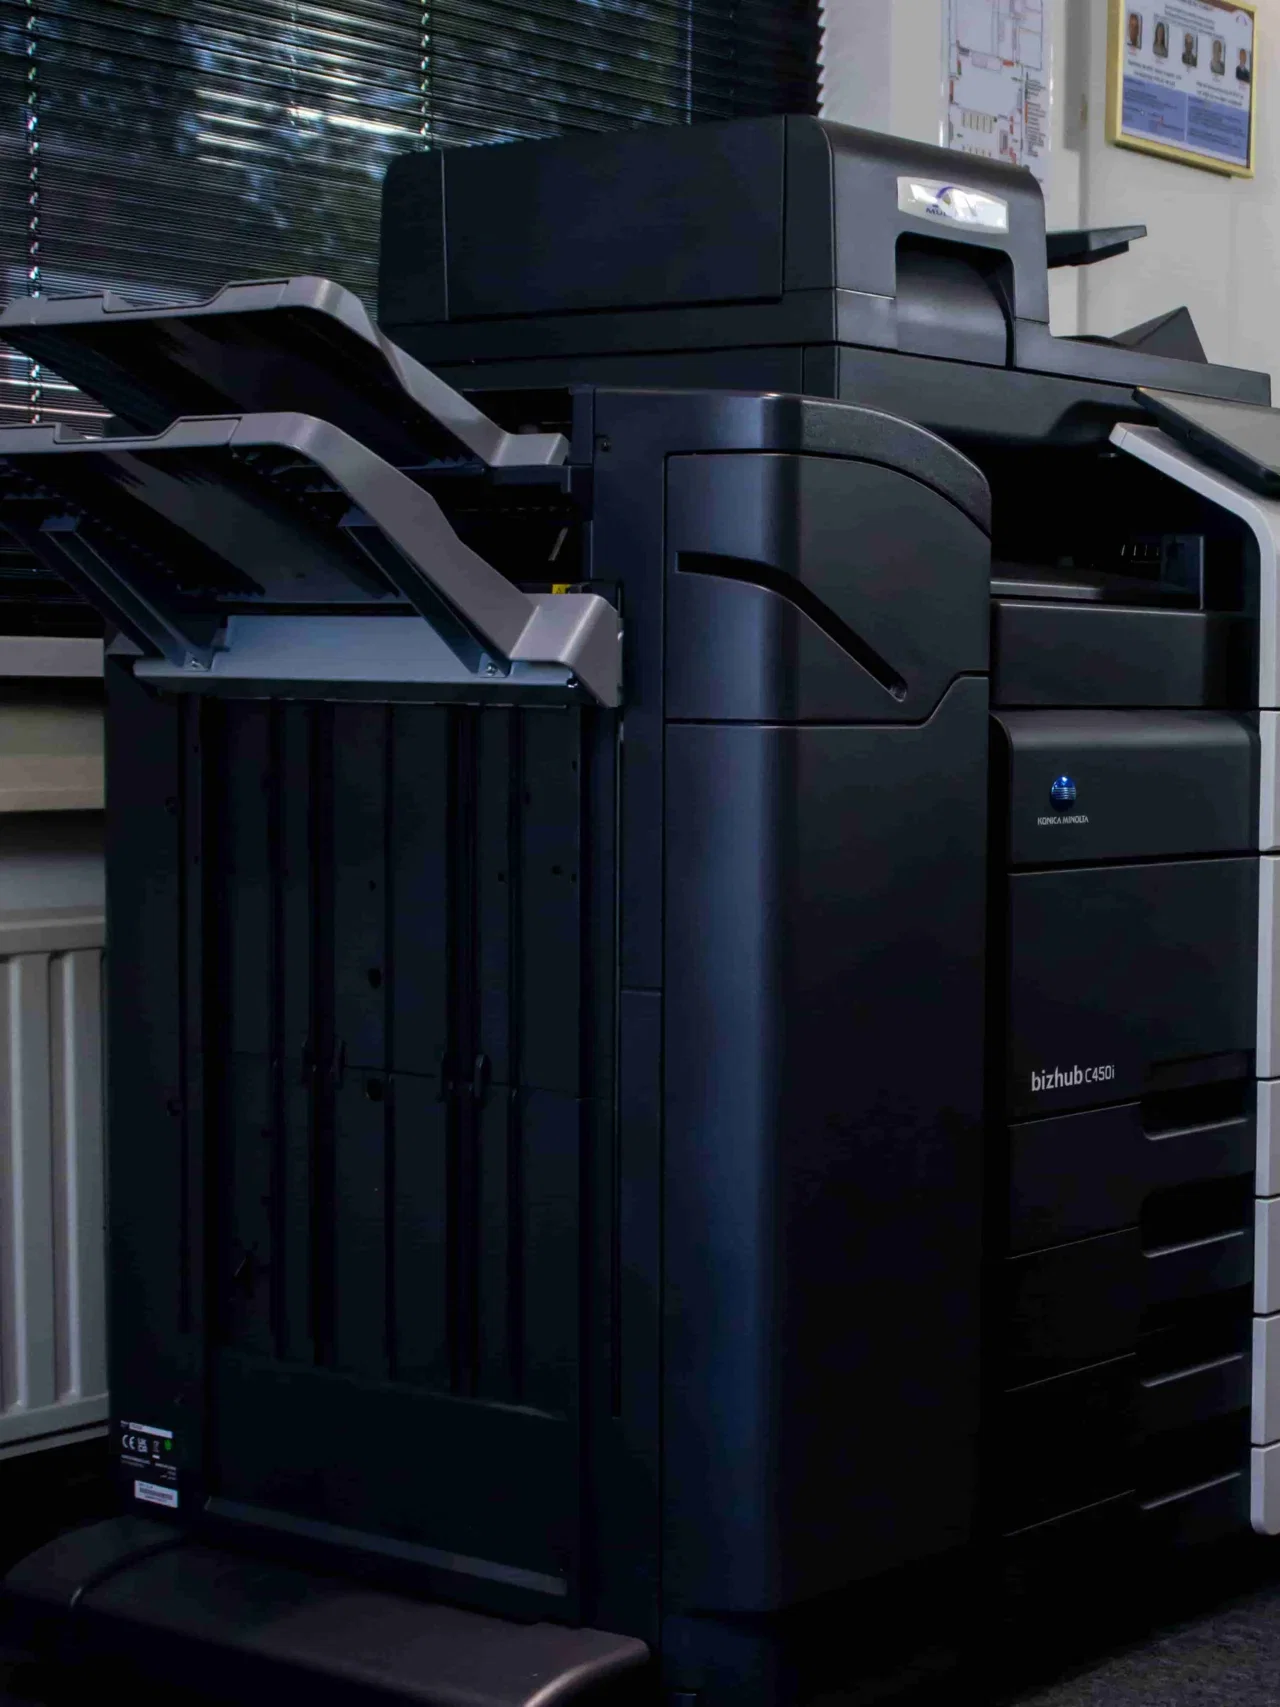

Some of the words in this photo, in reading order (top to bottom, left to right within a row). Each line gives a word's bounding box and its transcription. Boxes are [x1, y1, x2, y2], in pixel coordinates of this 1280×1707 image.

[1037, 816, 1062, 825] KONICA
[1062, 815, 1089, 824] MINOLTA
[1031, 1065, 1083, 1091] bizhub
[1085, 1065, 1115, 1082] C450i
